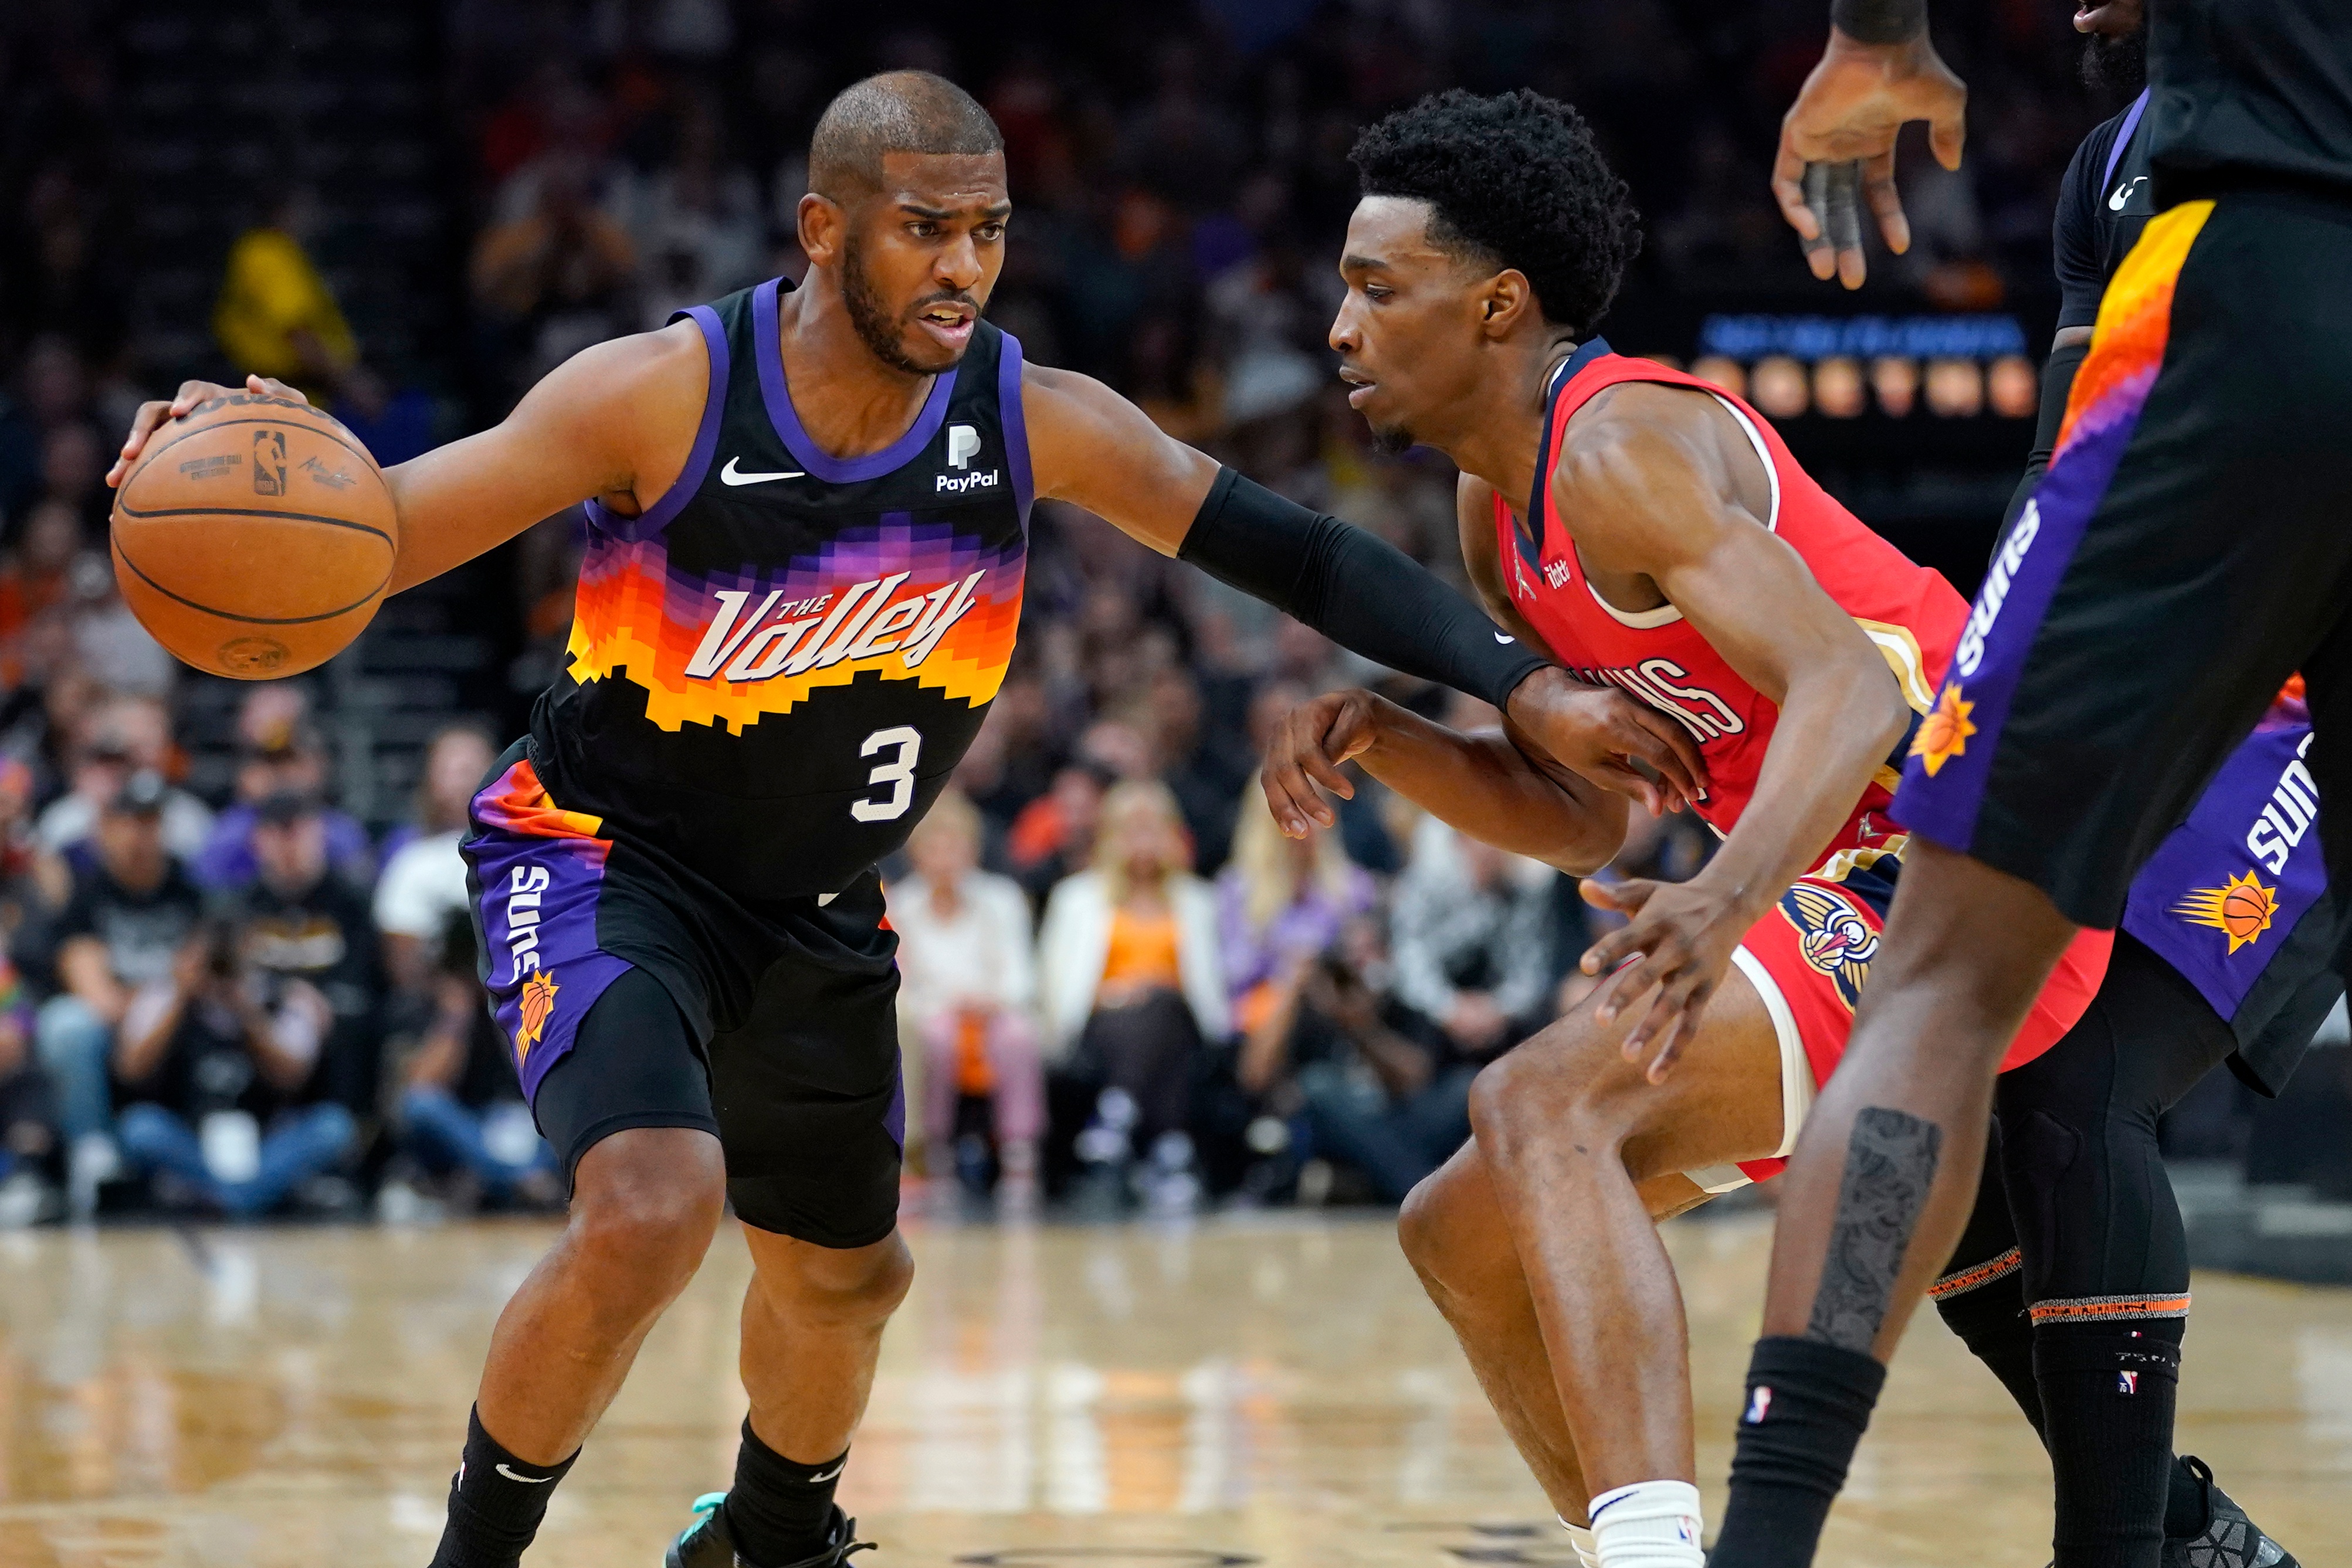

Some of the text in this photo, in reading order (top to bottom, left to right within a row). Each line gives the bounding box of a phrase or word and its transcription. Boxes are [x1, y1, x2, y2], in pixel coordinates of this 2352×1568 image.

[936, 469, 998, 493] PayPal
[684, 569, 987, 683] Valley
[776, 593, 834, 619] THE
[850, 725, 923, 823] 3
